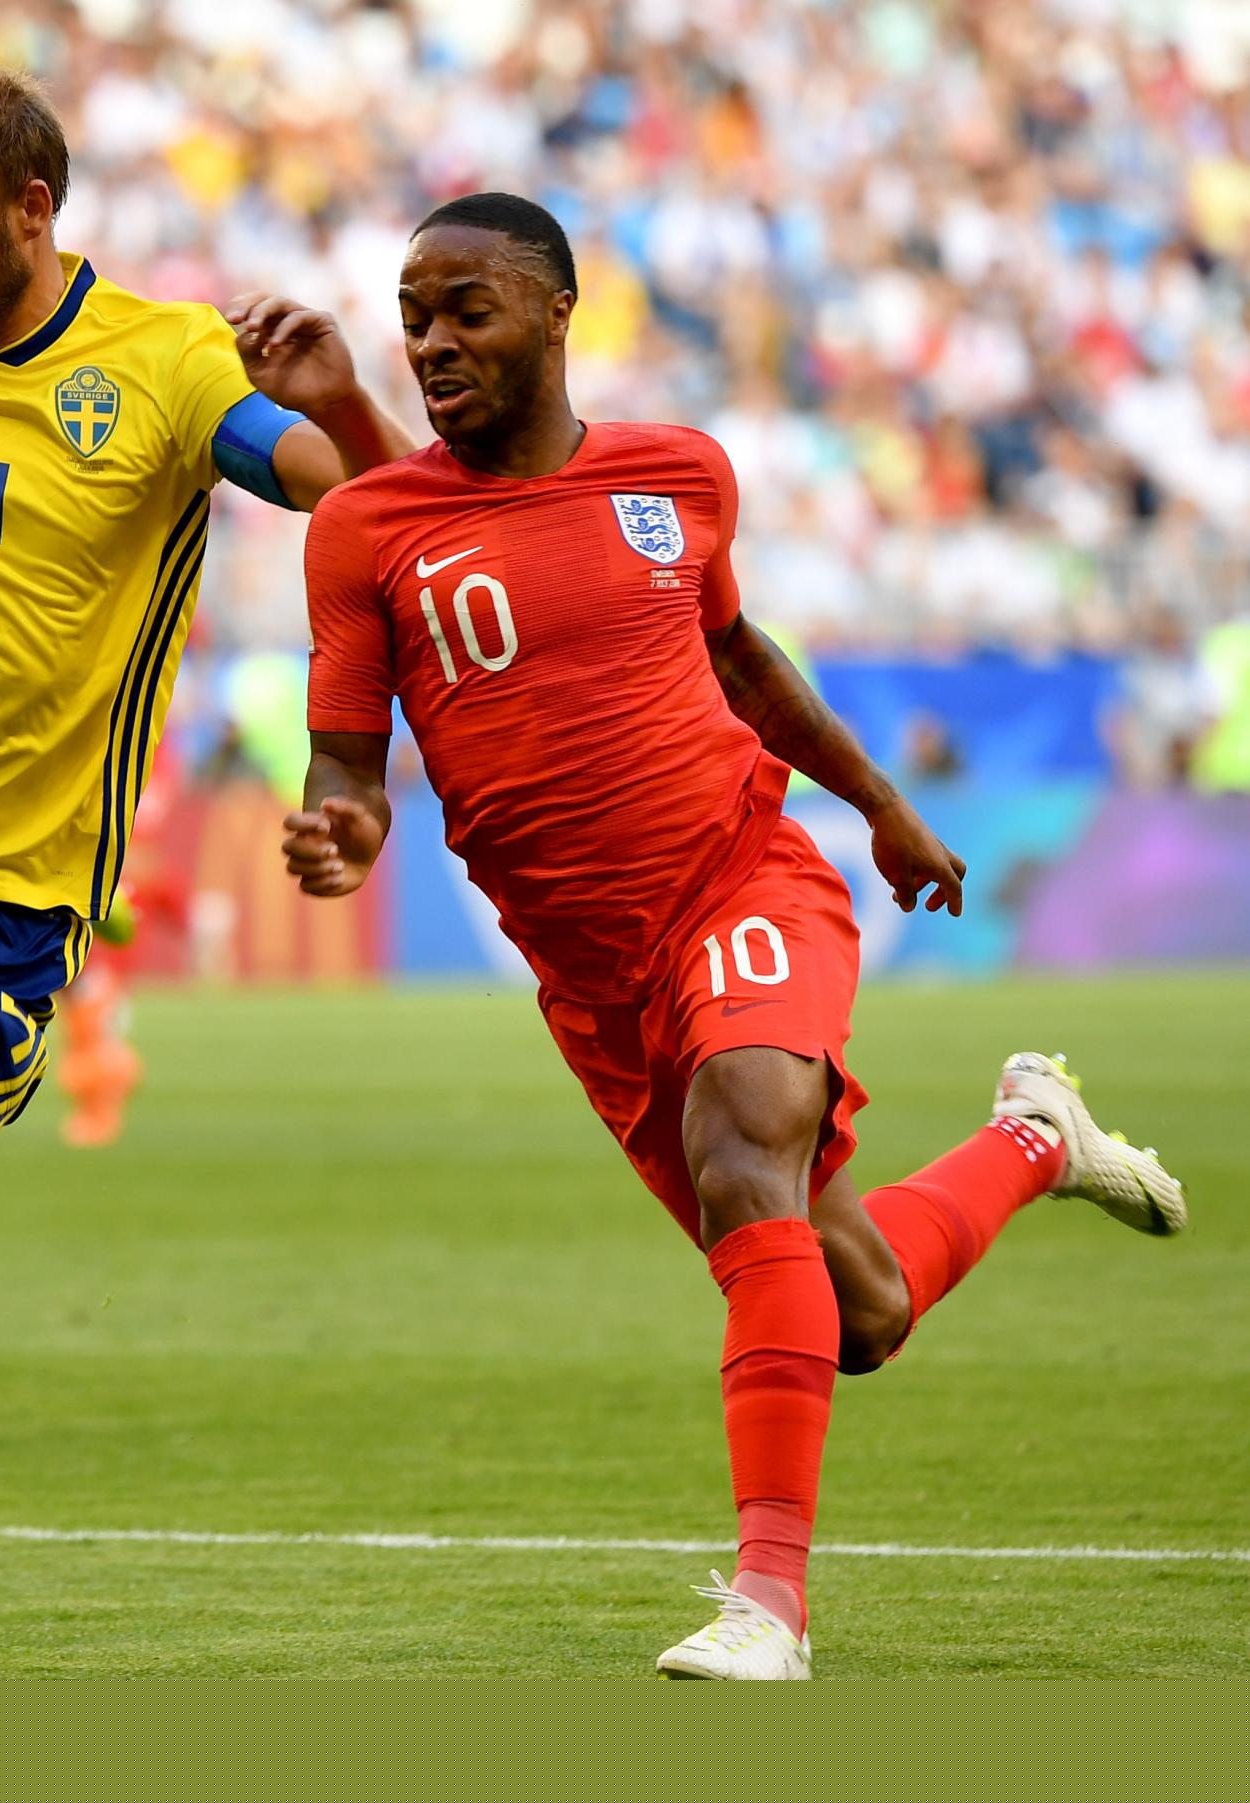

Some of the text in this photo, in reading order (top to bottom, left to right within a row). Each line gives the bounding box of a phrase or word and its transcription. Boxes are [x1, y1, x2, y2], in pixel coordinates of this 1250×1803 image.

[67, 391, 108, 400] SVERIGE
[419, 573, 518, 683] 10
[703, 915, 790, 998] 10
